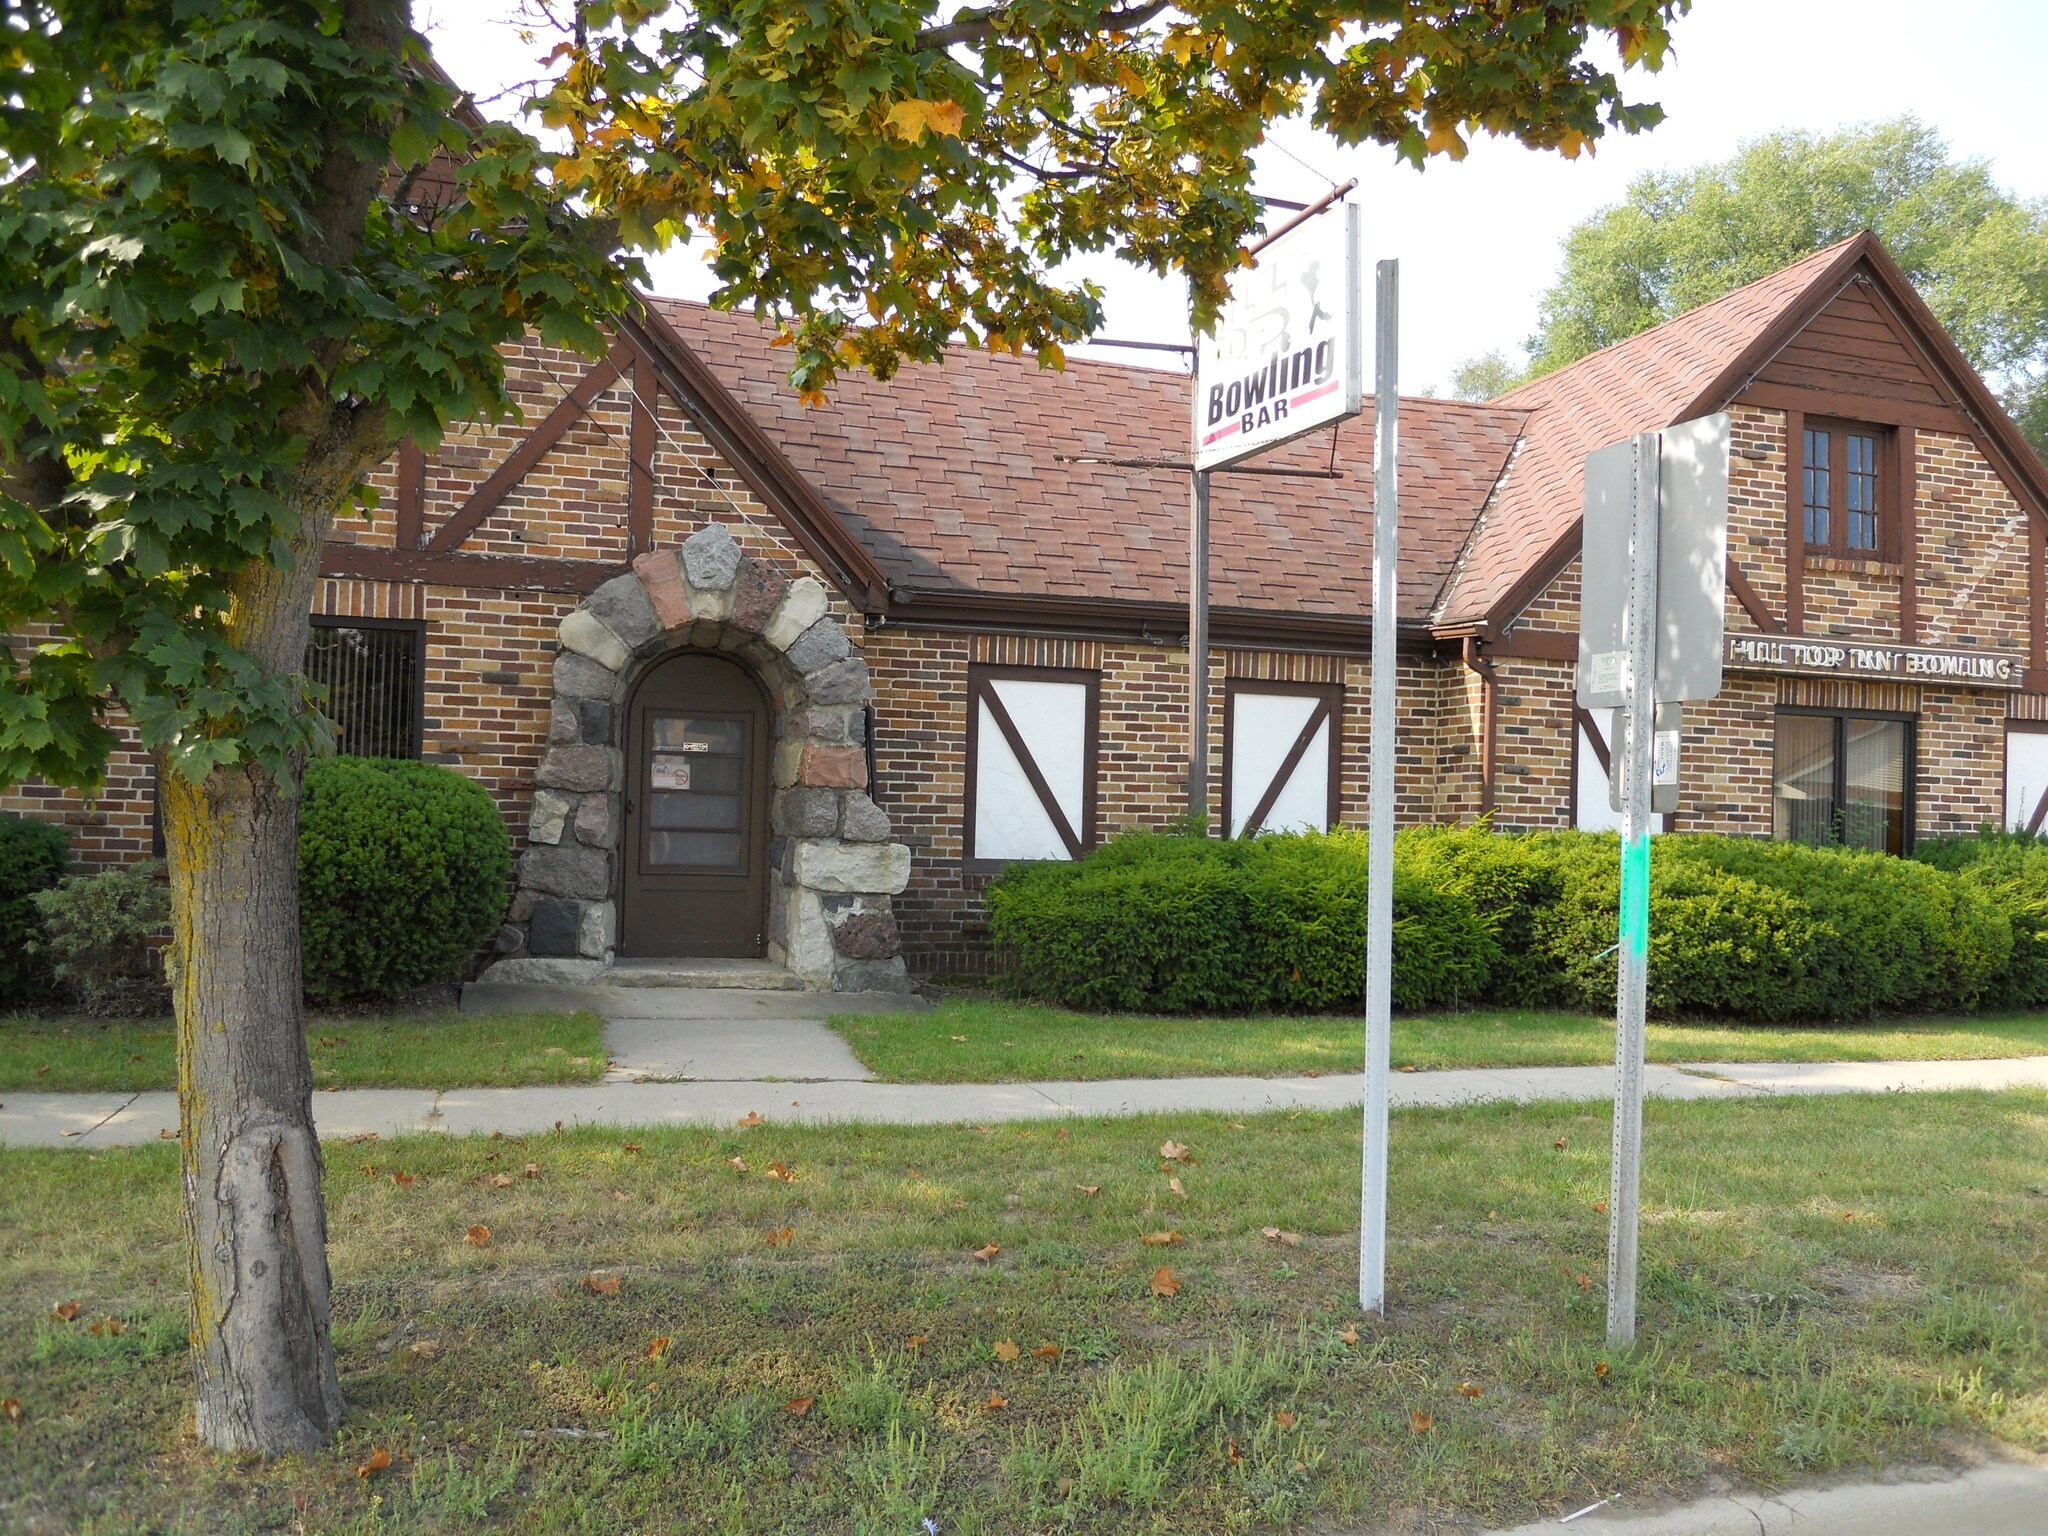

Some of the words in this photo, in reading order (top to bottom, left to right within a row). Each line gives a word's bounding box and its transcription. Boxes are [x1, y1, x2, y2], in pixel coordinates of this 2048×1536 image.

[1207, 336, 1336, 427] Bowling
[1241, 398, 1288, 435] BAR
[1905, 653, 2011, 680] BOWLING
